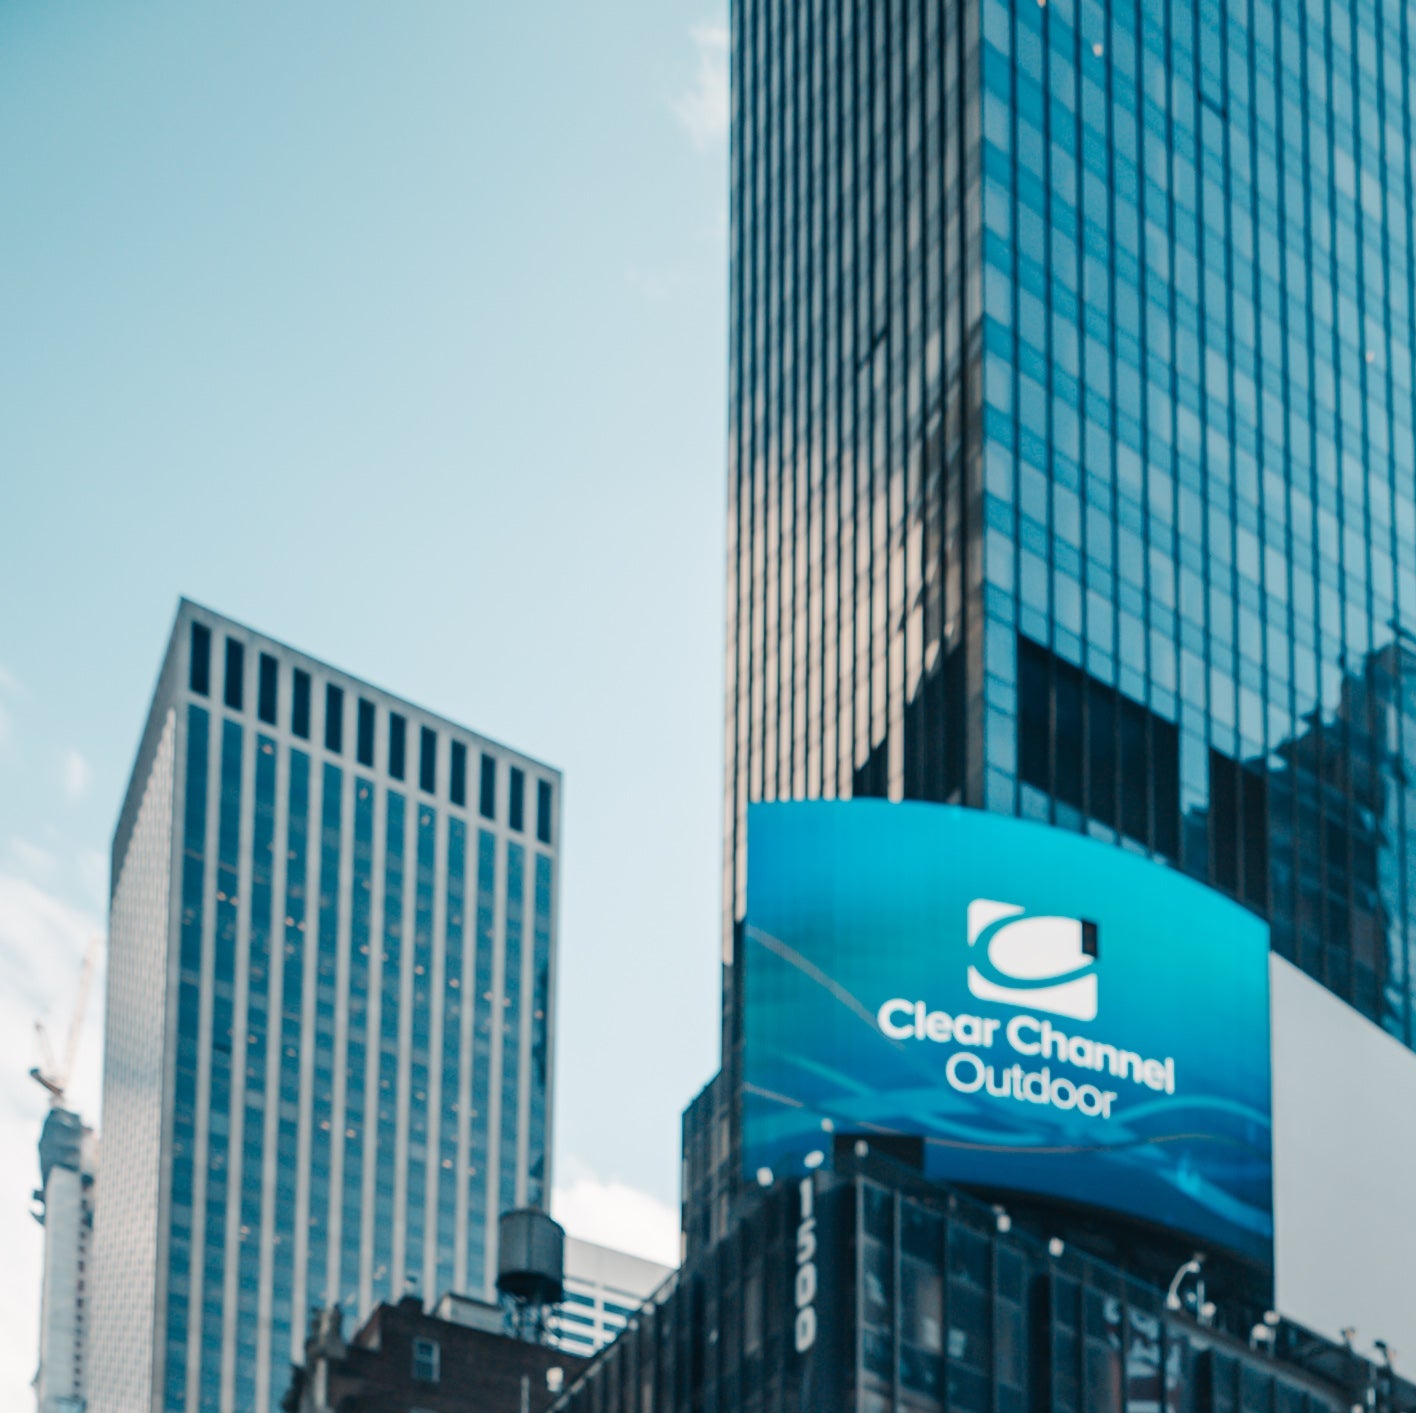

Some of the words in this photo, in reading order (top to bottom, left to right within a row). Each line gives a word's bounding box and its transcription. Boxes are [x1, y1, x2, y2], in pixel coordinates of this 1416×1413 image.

[877, 999, 1000, 1046] Clear
[1007, 1016, 1176, 1094] Channel
[946, 1053, 1117, 1119] Outdoor
